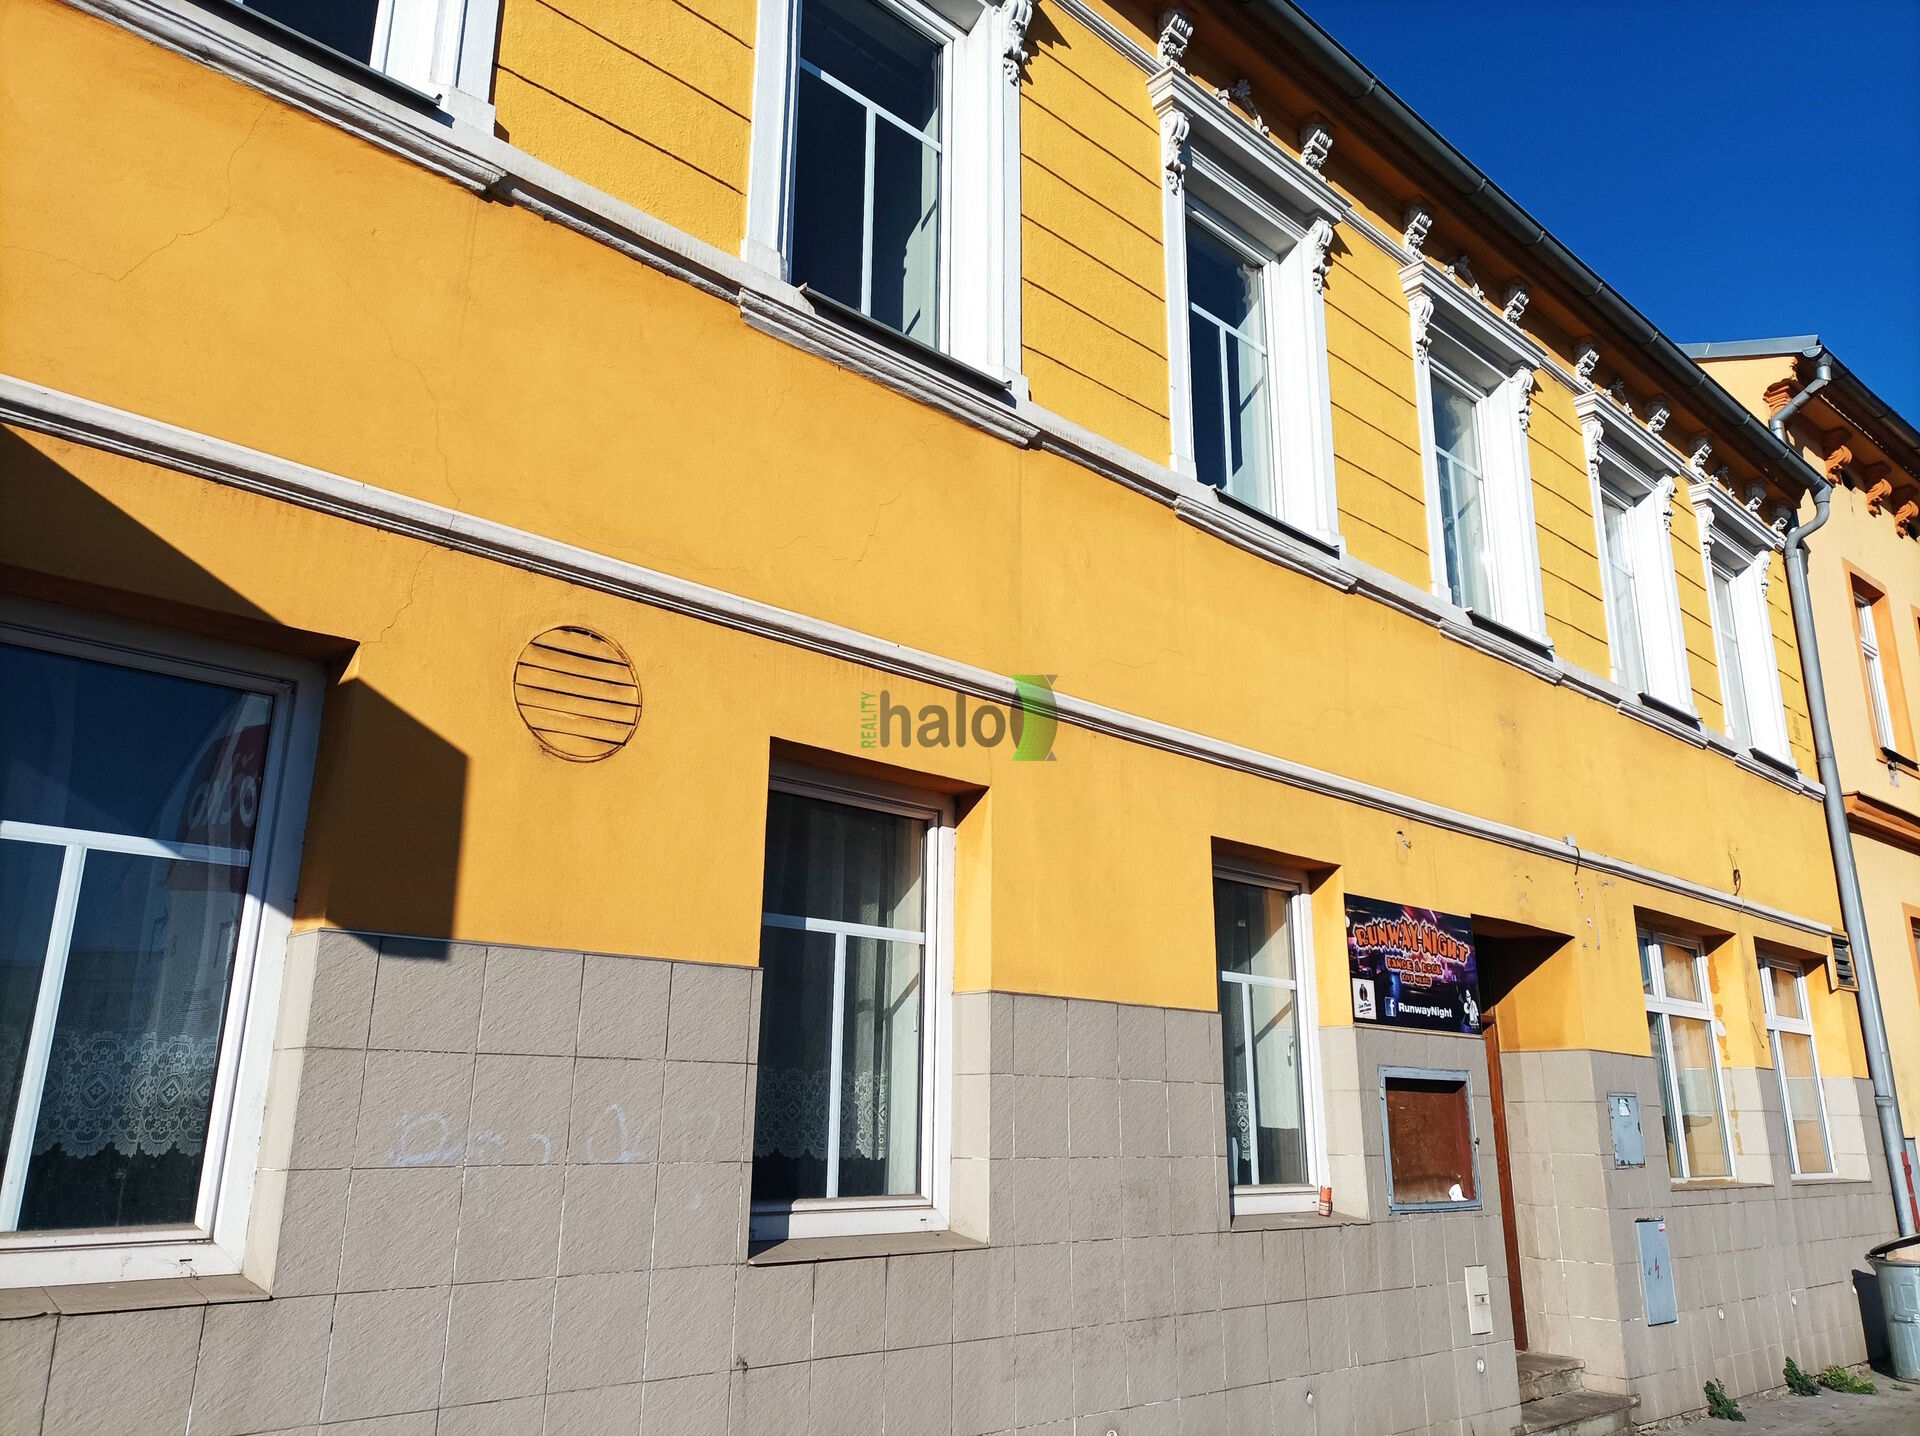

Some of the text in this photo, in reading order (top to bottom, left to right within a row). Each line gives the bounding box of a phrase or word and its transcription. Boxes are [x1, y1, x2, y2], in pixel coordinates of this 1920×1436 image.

[1355, 920, 1468, 963] RUNWAY NIGHT
[1398, 1002, 1453, 1018] RunwayNight
